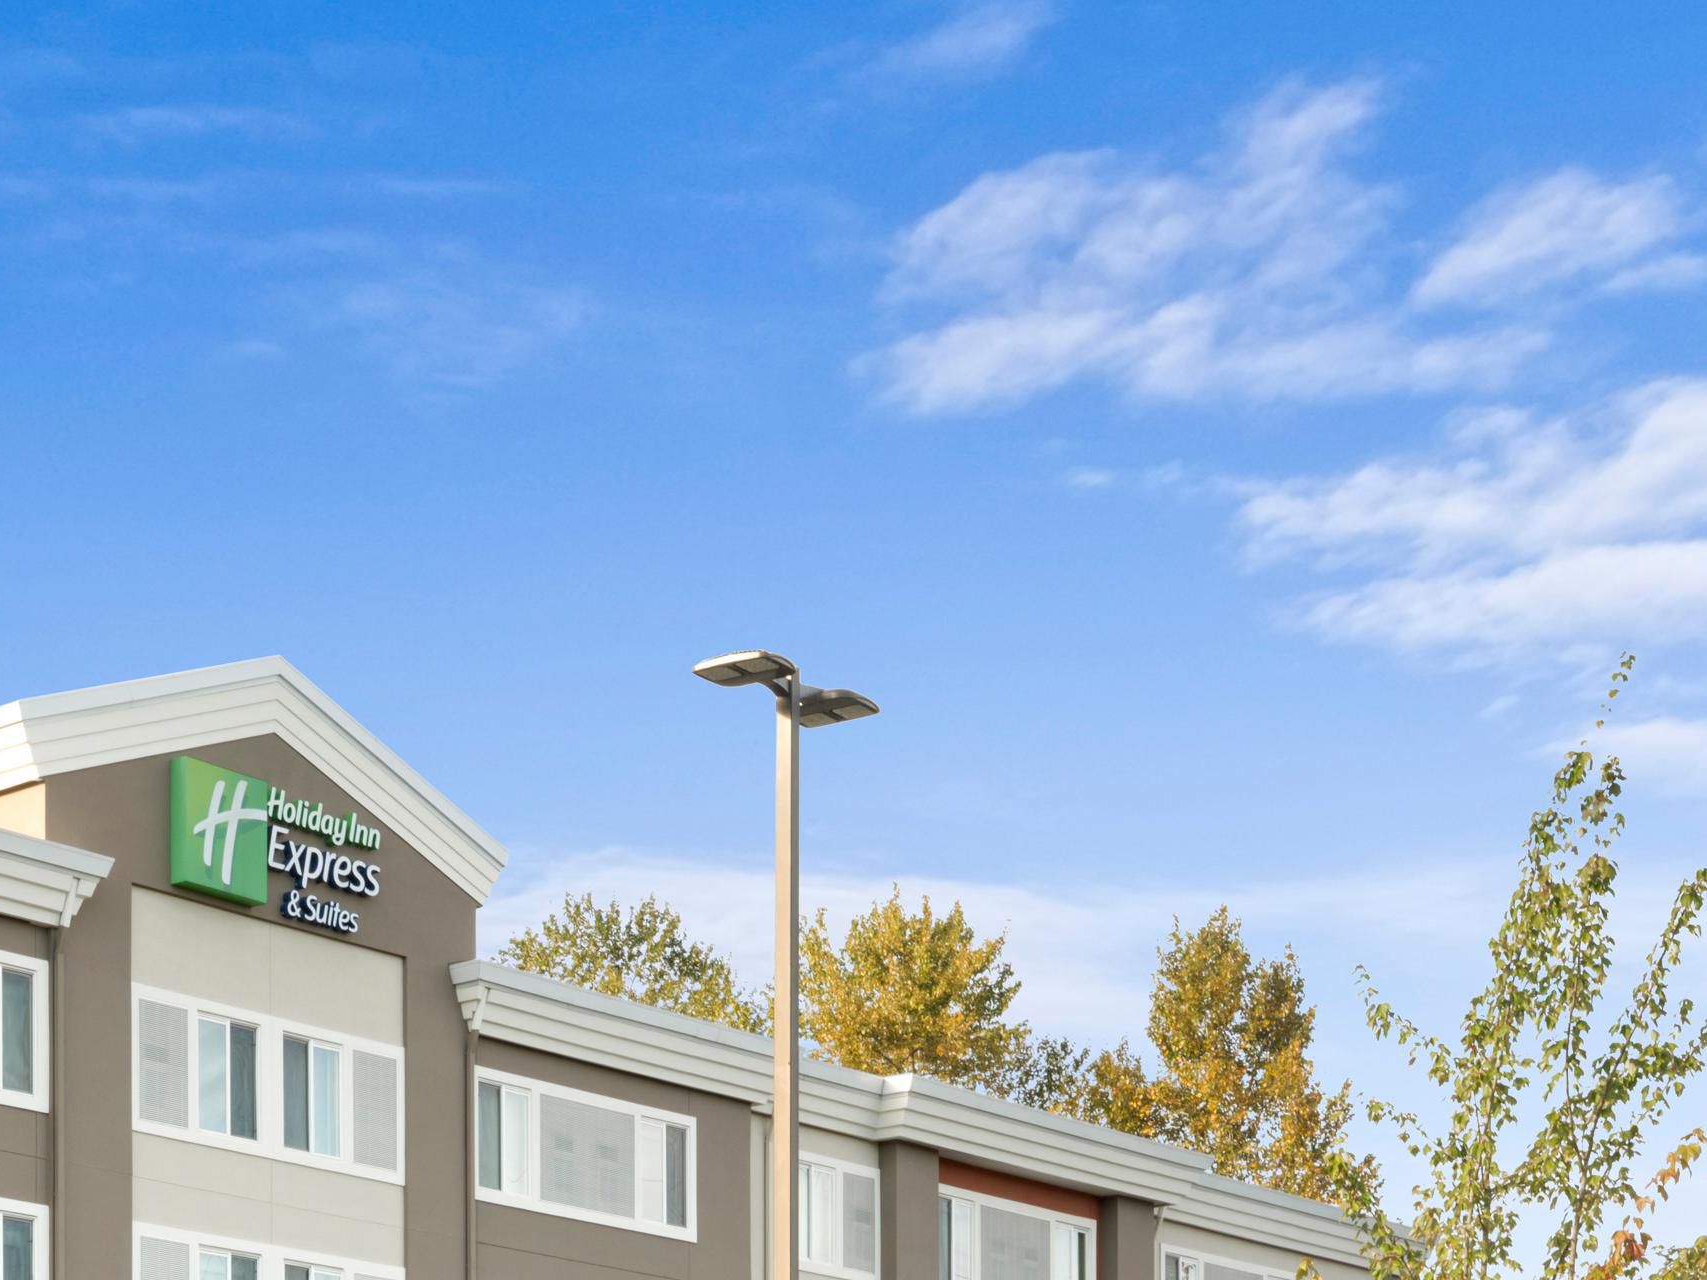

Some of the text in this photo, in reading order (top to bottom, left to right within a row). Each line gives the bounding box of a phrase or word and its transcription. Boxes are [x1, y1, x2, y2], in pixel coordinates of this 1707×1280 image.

[266, 786, 381, 850] Holiday Inn
[267, 825, 381, 897] Express
[286, 889, 359, 933] & Suites
